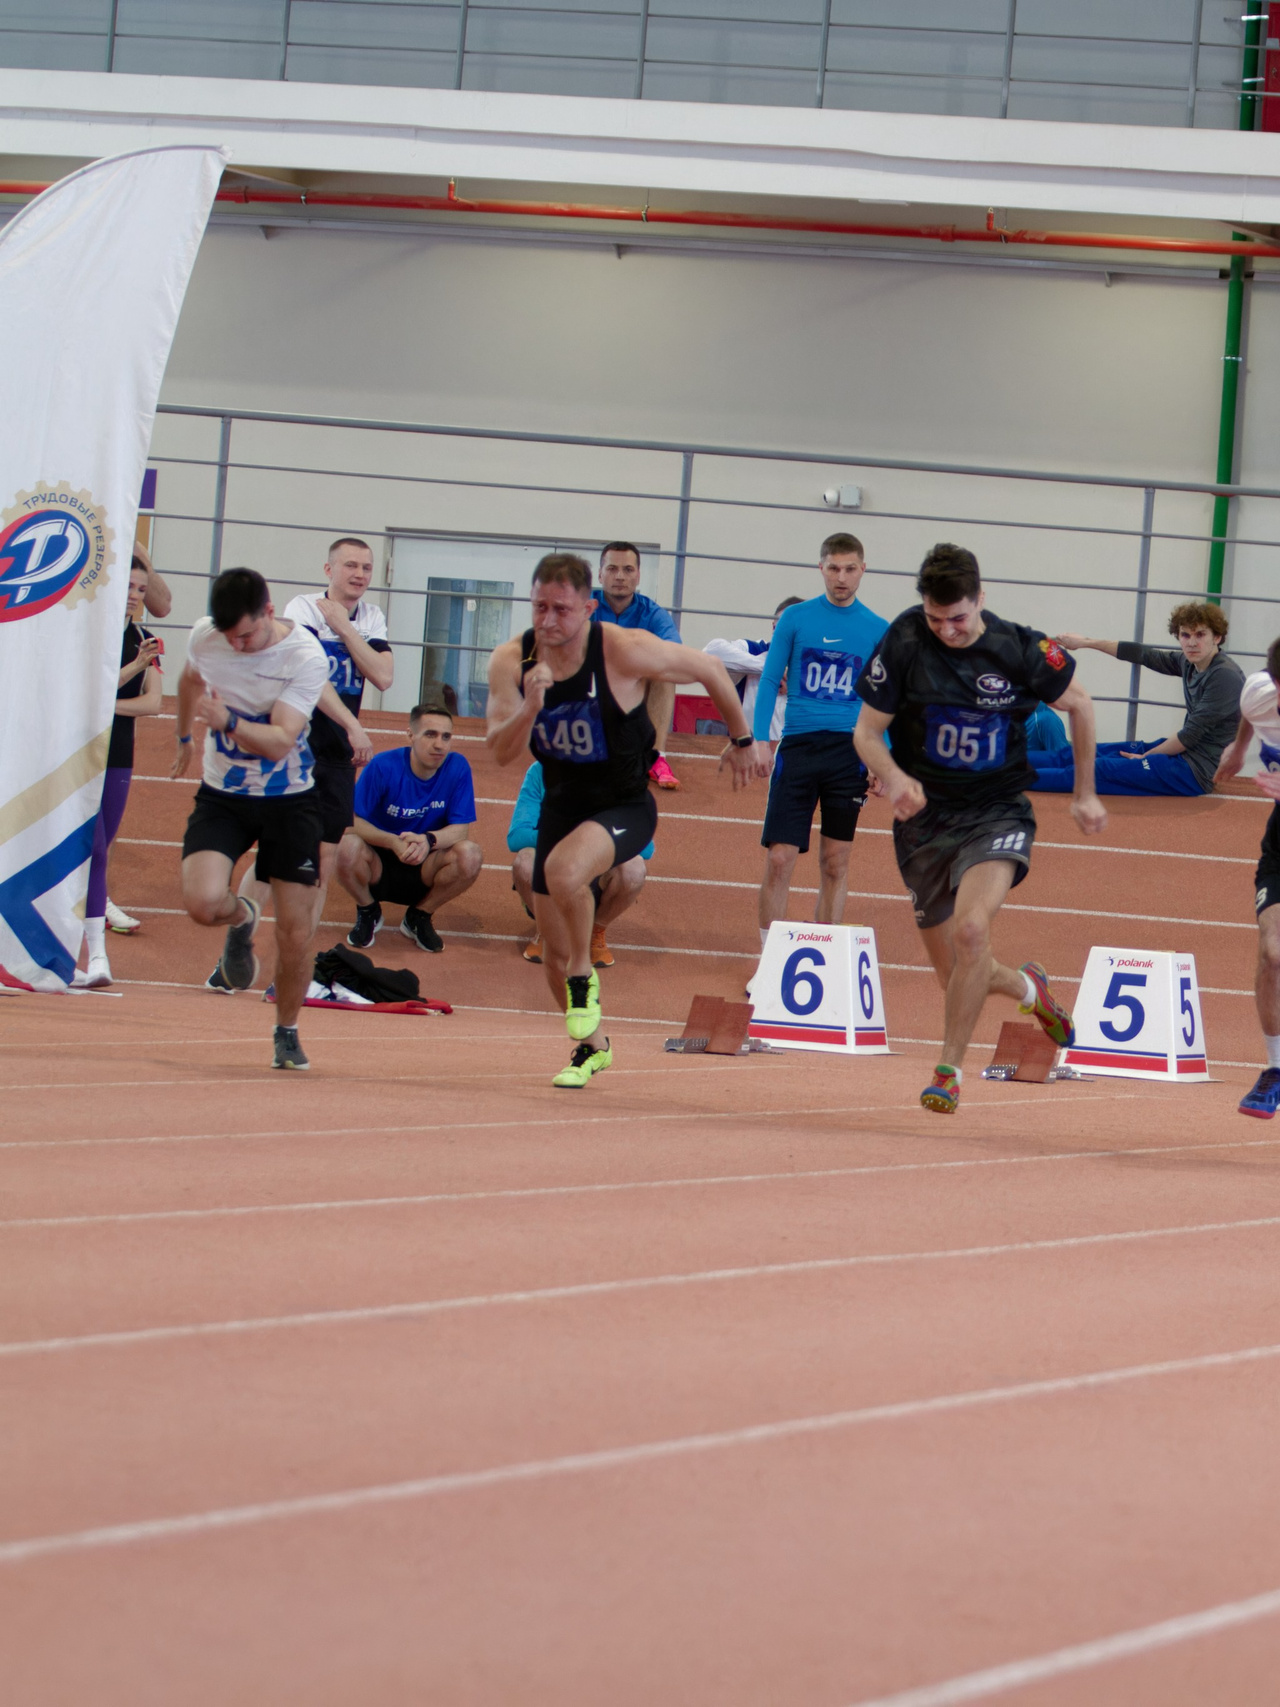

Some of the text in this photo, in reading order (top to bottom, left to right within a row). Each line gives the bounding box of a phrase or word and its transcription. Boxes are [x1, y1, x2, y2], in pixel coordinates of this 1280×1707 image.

[23, 492, 105, 589] ТРУДОВЫЕ РЕЗЕРВЫ
[805, 662, 853, 696] 044
[936, 724, 1000, 763] 051
[796, 932, 834, 943] polanik
[1117, 958, 1154, 968] polanik
[781, 947, 826, 1016] 6
[858, 951, 874, 1020] 6
[1099, 972, 1147, 1042] 5
[1180, 977, 1195, 1047] 5
